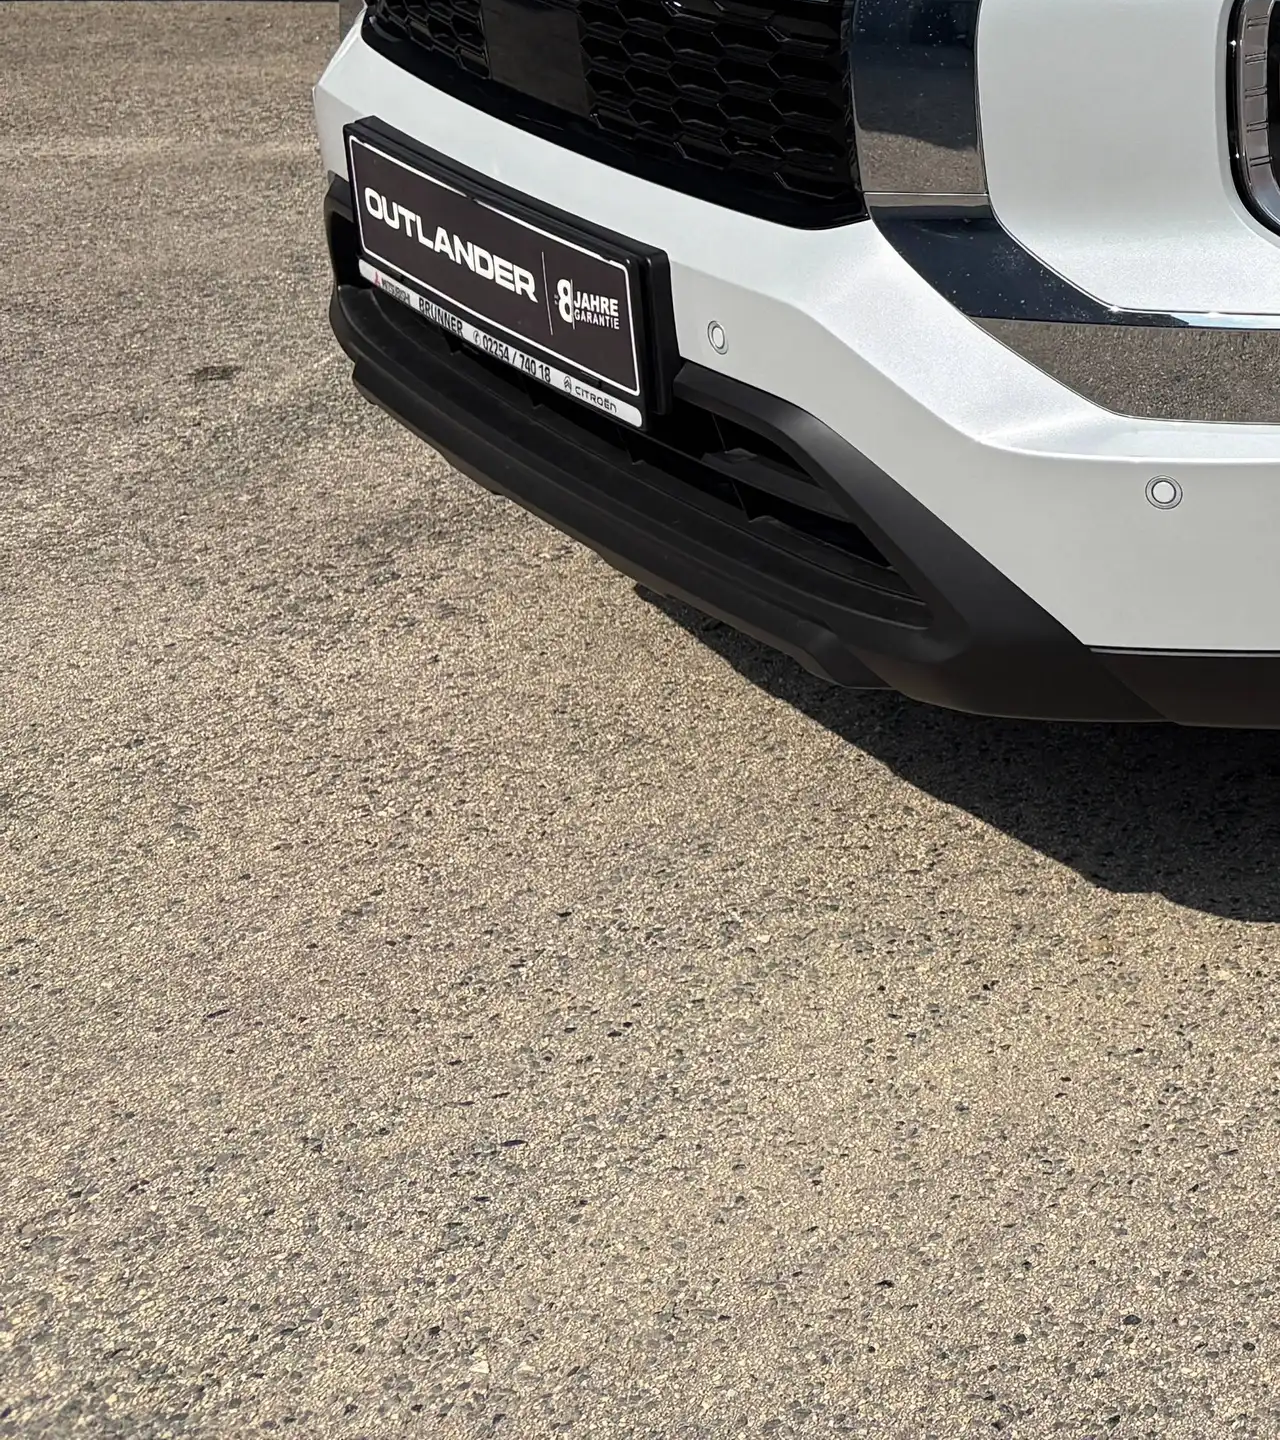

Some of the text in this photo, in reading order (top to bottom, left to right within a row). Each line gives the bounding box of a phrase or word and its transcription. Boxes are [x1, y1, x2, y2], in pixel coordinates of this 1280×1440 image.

[364, 186, 539, 304] OUTLANDER
[557, 278, 619, 323] 8 JAHRE
[574, 308, 620, 330] GARANTIE
[418, 297, 464, 340] BRUNNER
[482, 334, 509, 362] 02254
[519, 353, 537, 376] 740
[538, 364, 551, 383] 18
